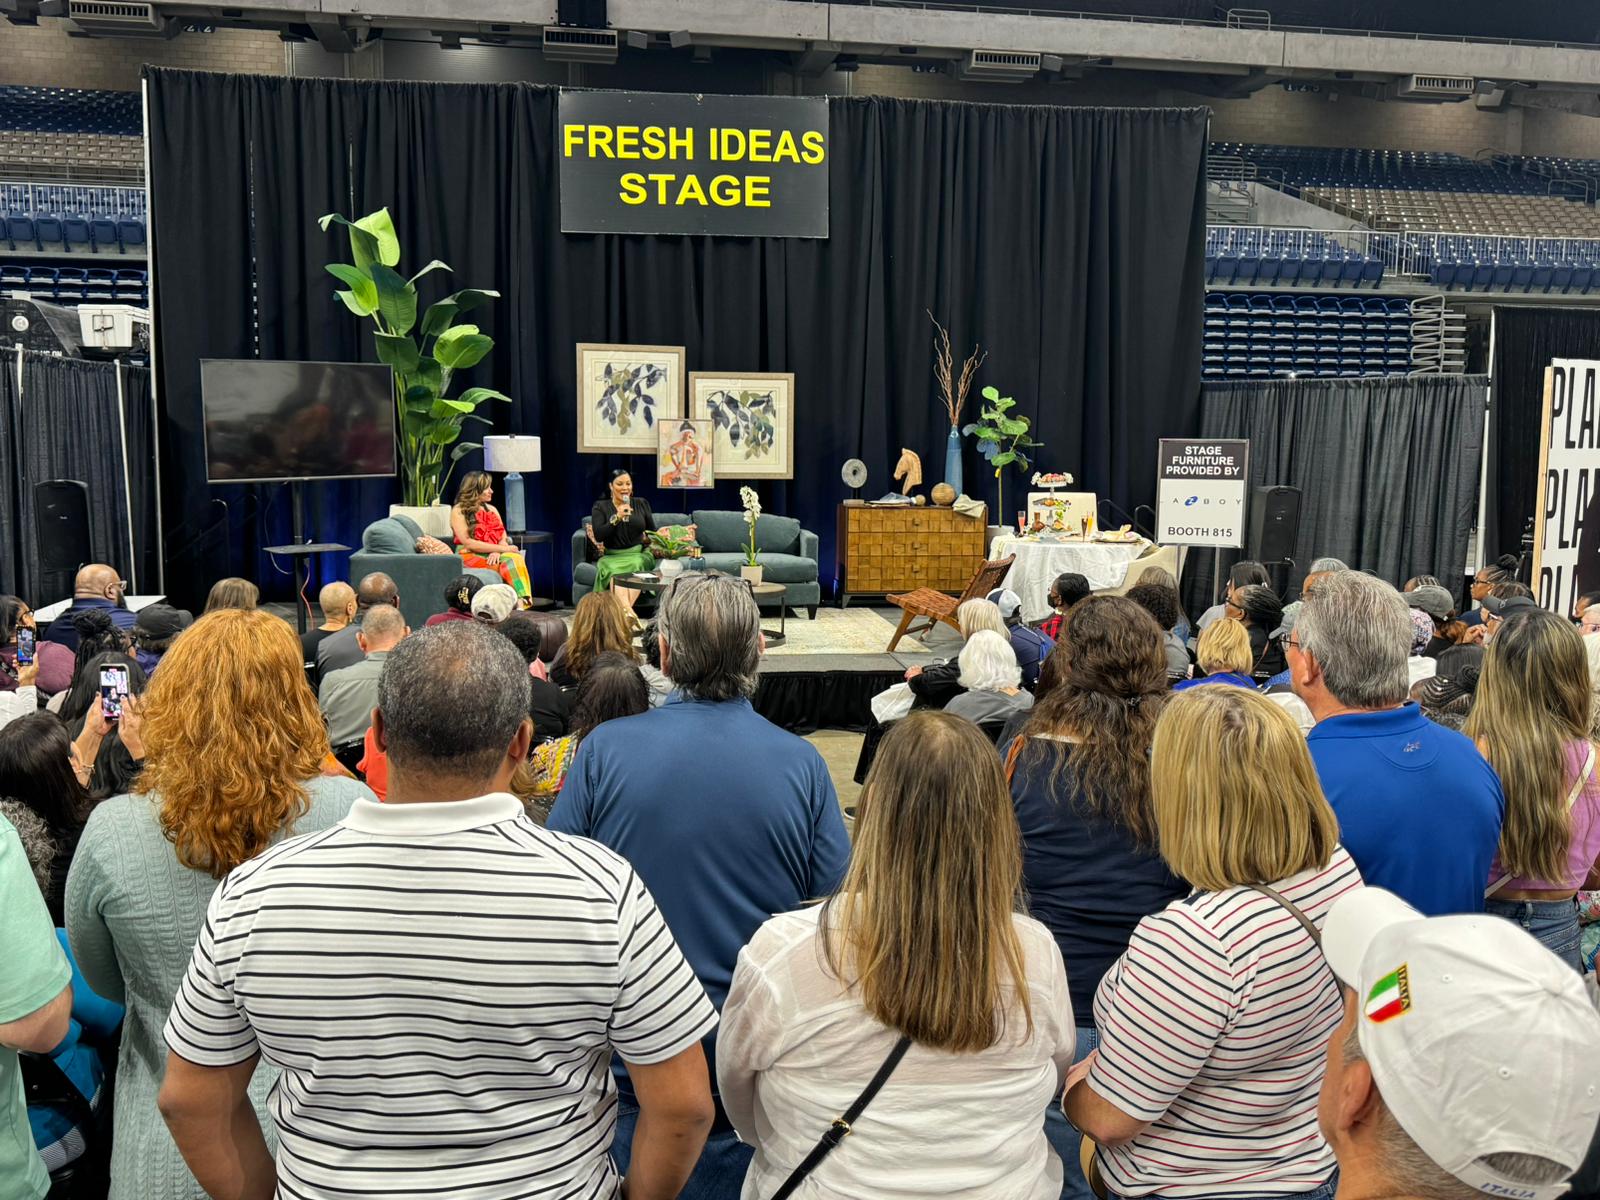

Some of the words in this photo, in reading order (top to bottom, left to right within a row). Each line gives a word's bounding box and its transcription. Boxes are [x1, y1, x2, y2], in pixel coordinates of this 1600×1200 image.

[563, 124, 694, 161] FRESH
[709, 127, 825, 165] IDEAS
[619, 172, 771, 208] STAGE
[1185, 446, 1222, 455] STAGE
[1172, 456, 1234, 466] FURNITURE
[1166, 466, 1221, 476] PROVIDED
[1224, 467, 1240, 476] BY
[1543, 468, 1600, 550] PLA
[1167, 526, 1209, 537] BOOTH
[1212, 528, 1233, 538] 815
[1481, 1182, 1536, 1198] ITALIA
